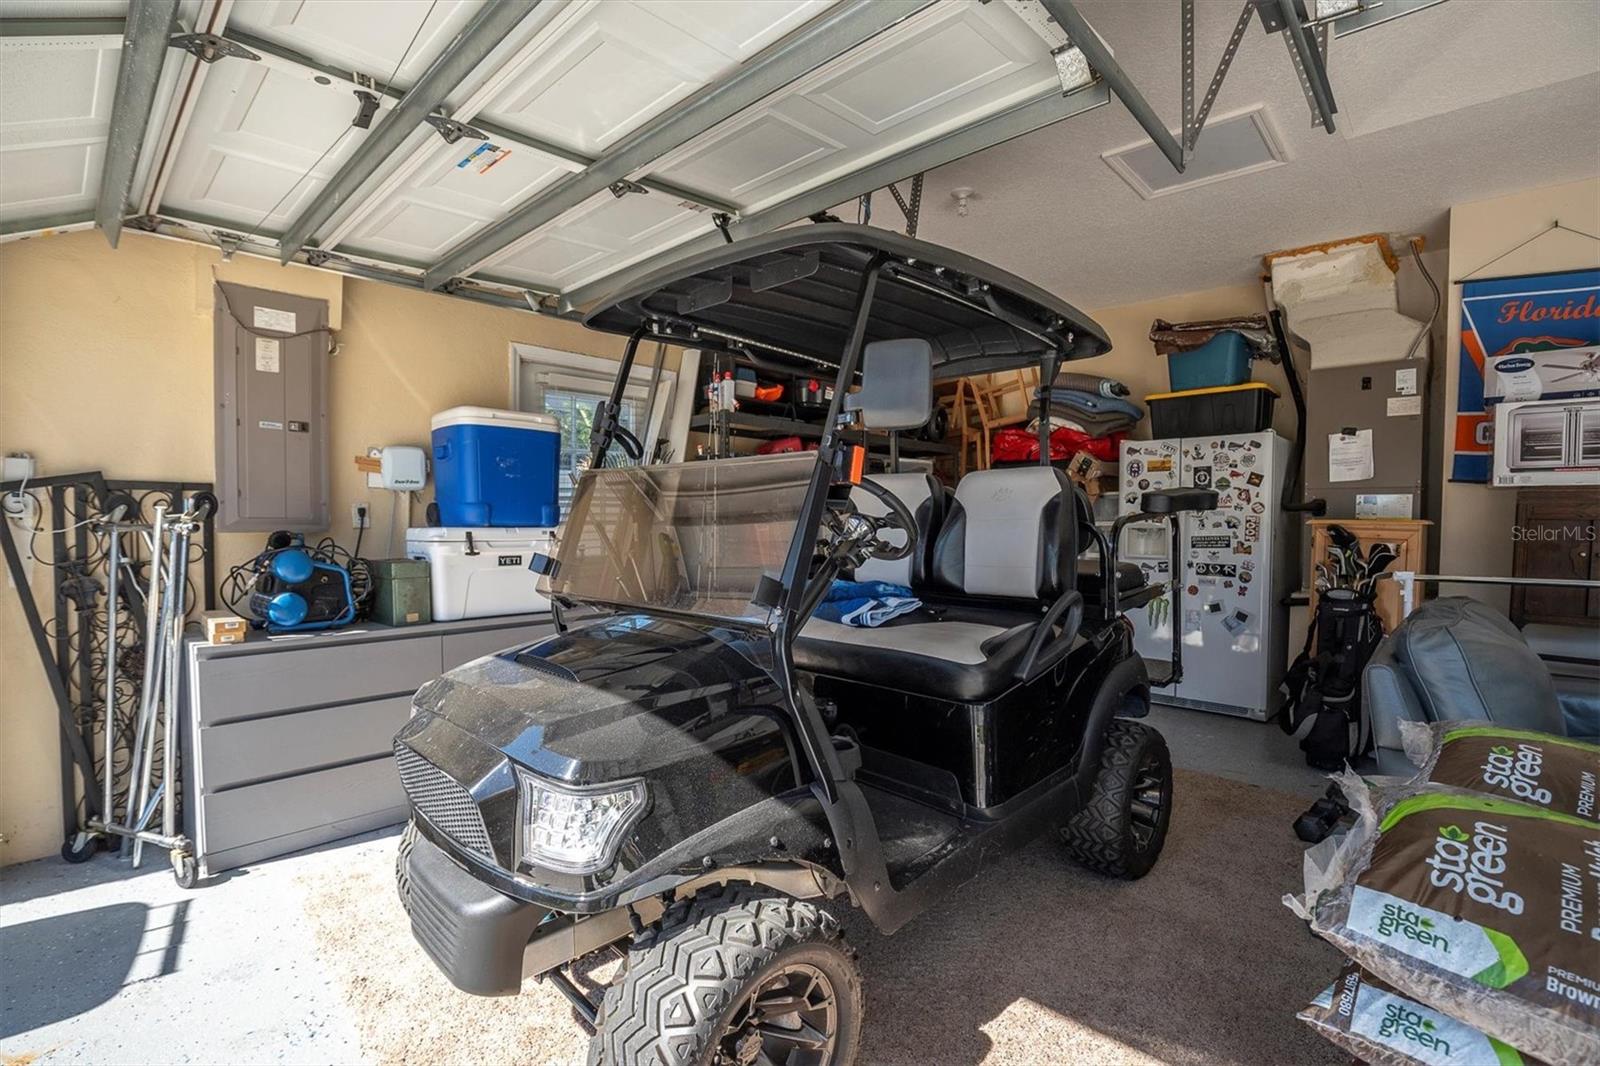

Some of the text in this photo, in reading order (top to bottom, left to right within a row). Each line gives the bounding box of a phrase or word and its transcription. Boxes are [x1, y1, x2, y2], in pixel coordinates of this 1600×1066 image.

[500, 557, 521, 565] YETI
[1480, 752, 1514, 789] sta
[1509, 744, 1553, 804] green
[1576, 770, 1596, 817] PREMIUM
[1425, 836, 1469, 893] sta
[1464, 821, 1525, 915] green
[1383, 903, 1420, 927] sta
[1560, 862, 1583, 935] PREMIUM
[1378, 915, 1450, 953] green
[1548, 965, 1600, 991] PREMIU
[1385, 1003, 1422, 1028] sta
[1379, 1017, 1451, 1056] green
